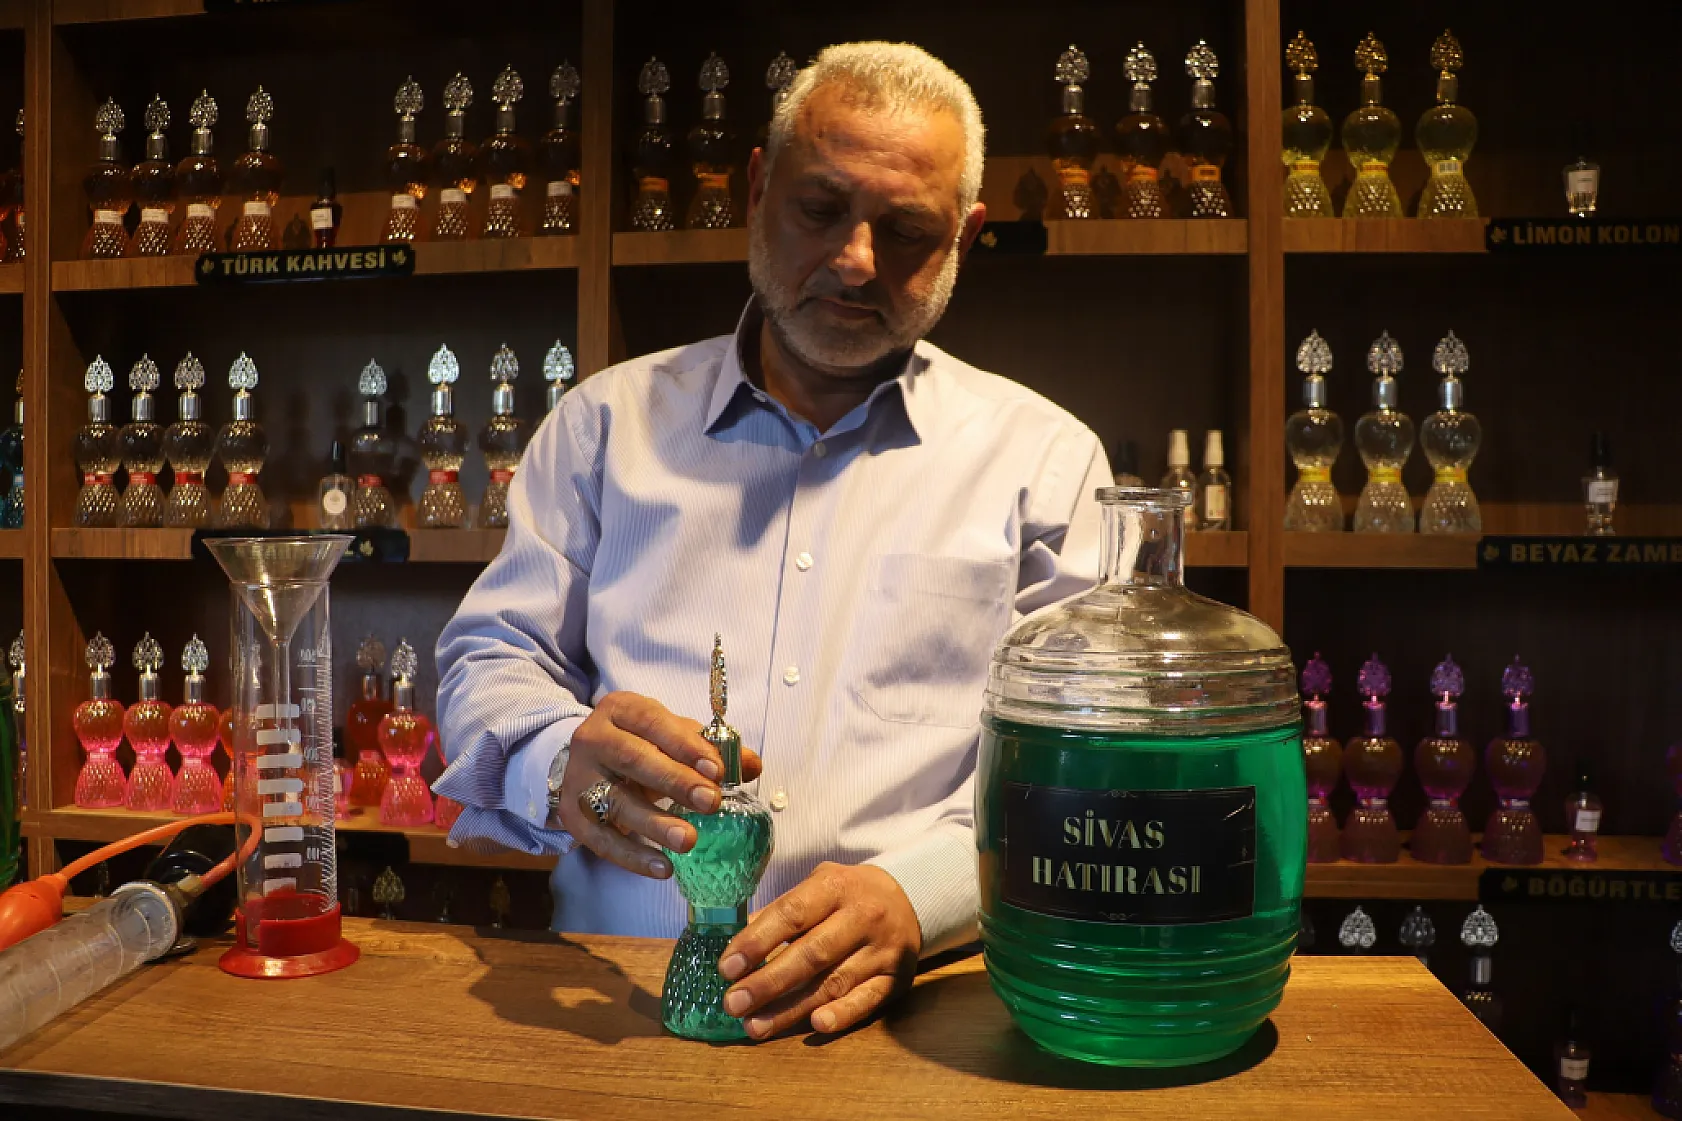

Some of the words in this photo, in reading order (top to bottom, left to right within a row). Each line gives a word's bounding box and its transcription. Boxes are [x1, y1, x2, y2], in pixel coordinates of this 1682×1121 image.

[1512, 222, 1591, 245] LİMON
[222, 255, 279, 275] TÜRK
[287, 248, 387, 271] KAHVESİ
[1511, 543, 1598, 563] BEYAZ
[1063, 809, 1165, 848] SİVAS
[1032, 855, 1201, 894] HATIRASI
